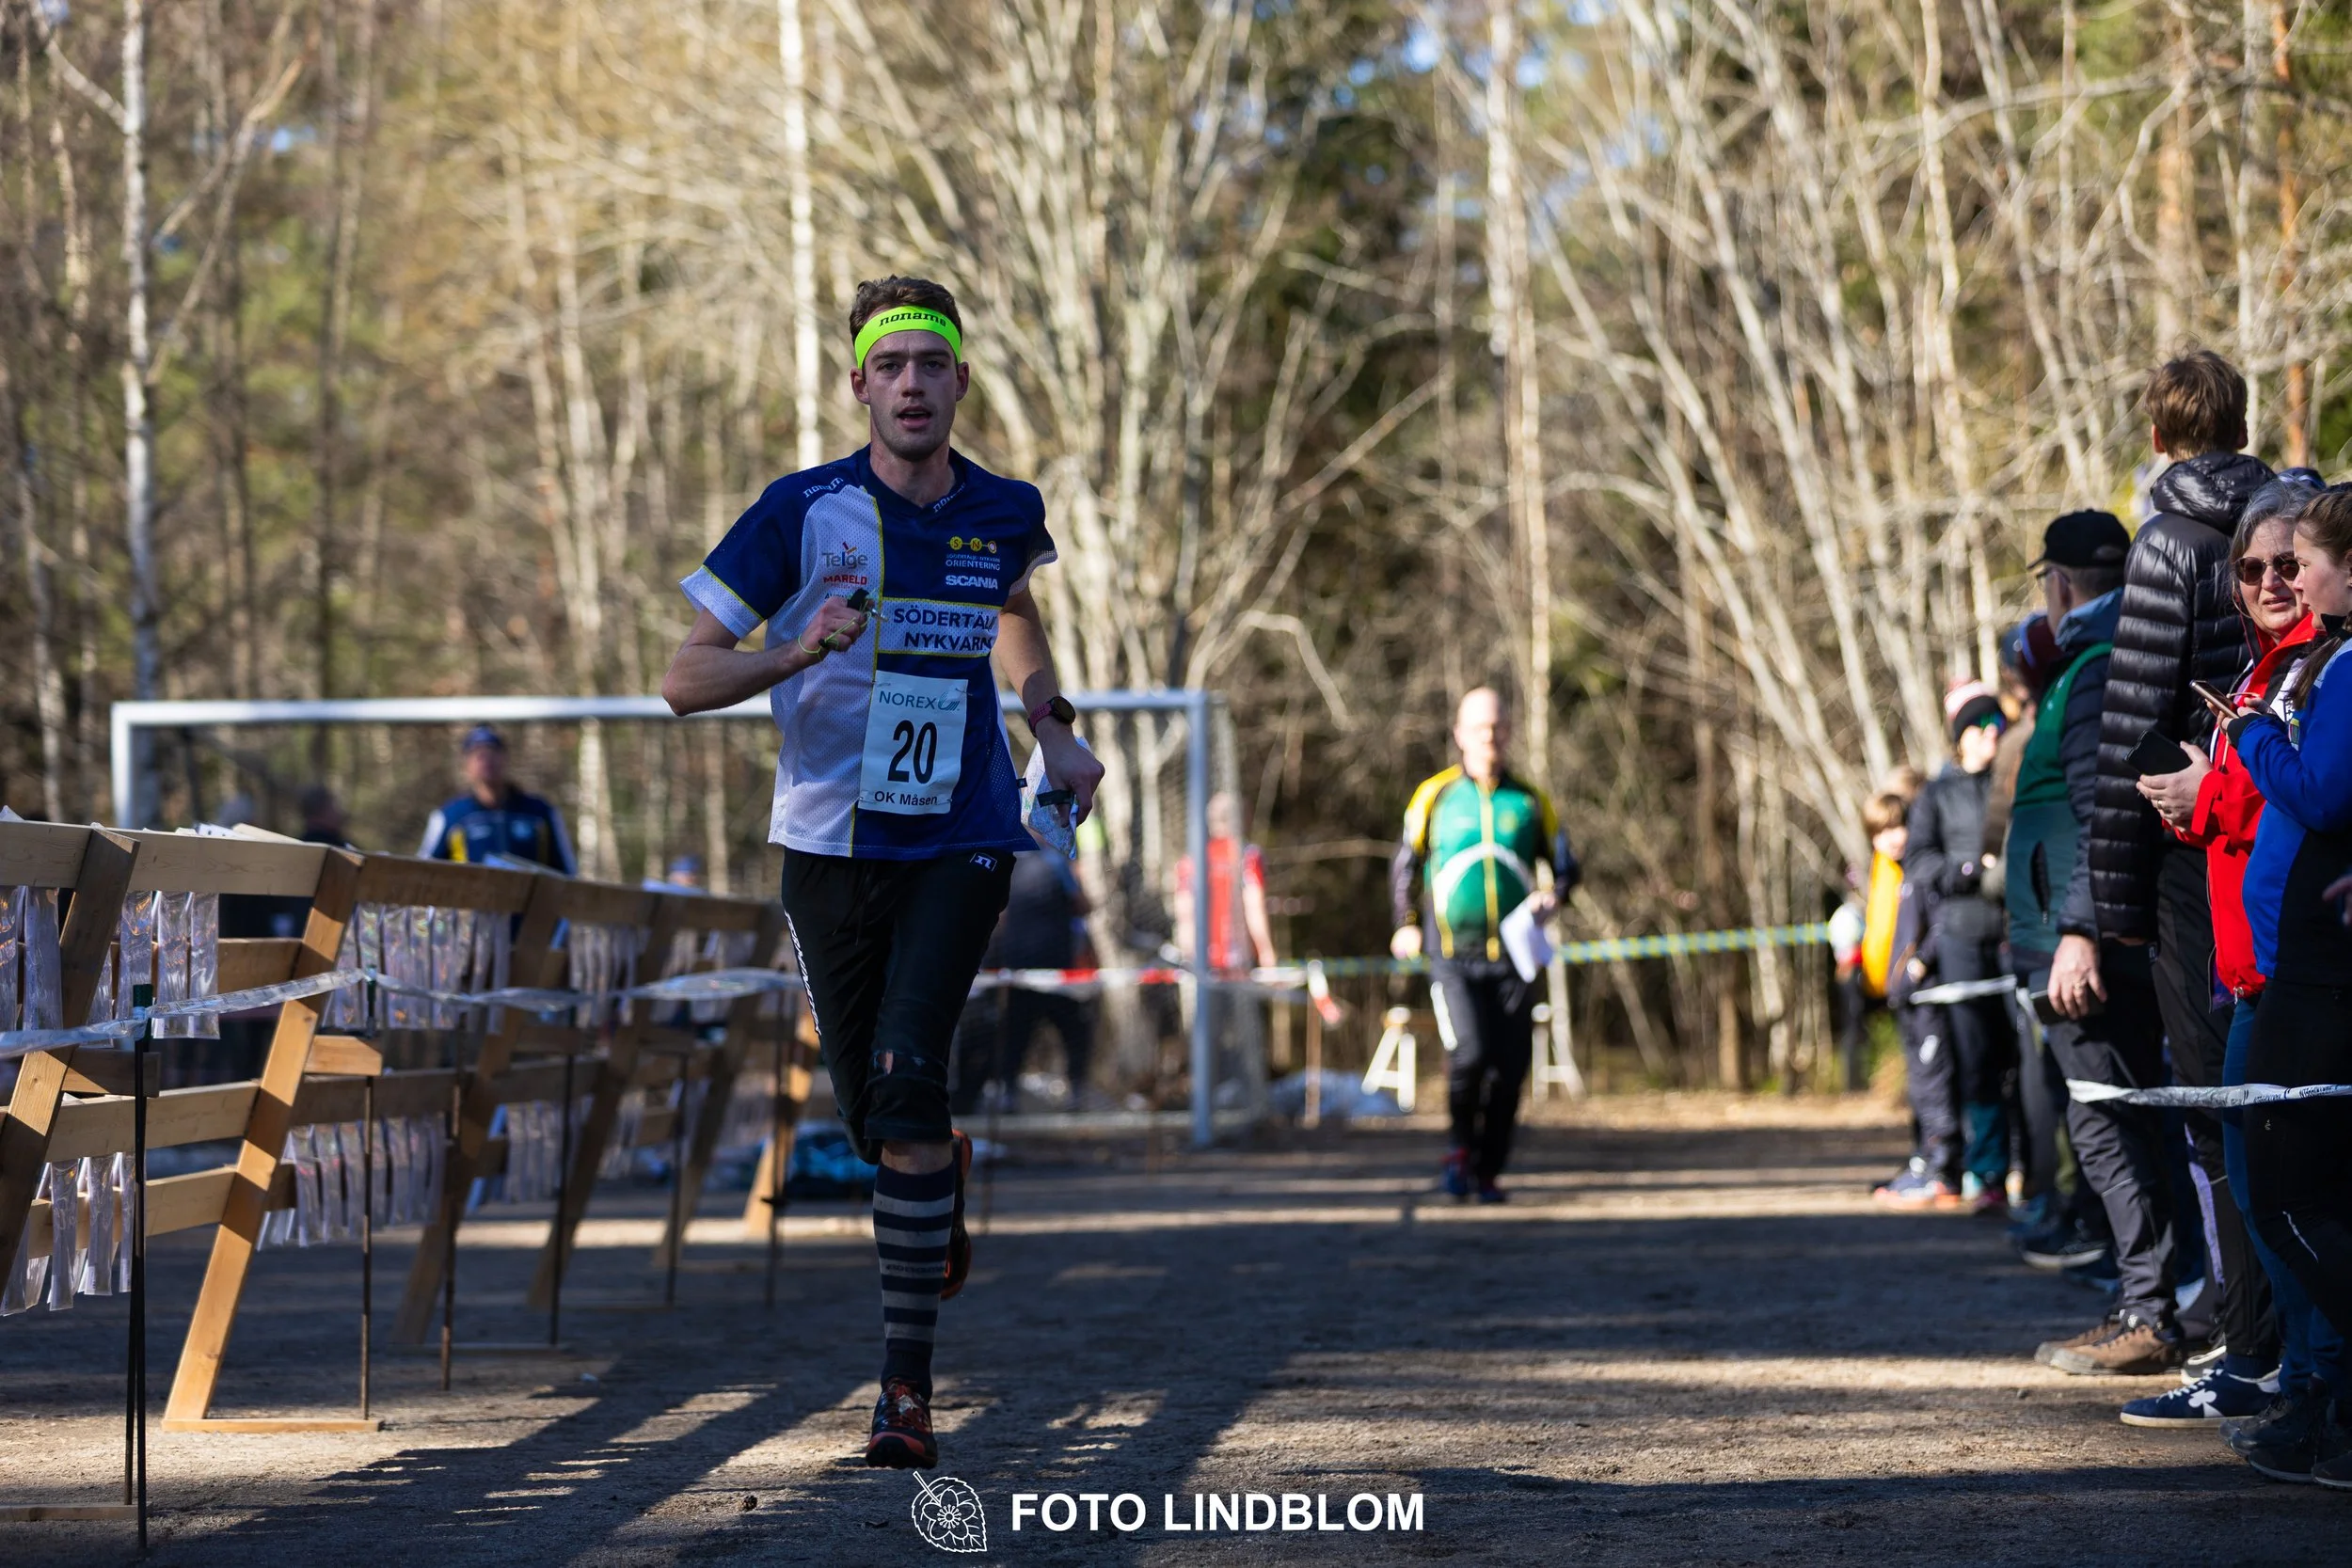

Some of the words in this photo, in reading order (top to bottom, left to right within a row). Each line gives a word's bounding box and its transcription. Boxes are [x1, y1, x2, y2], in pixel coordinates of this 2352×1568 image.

[879, 312, 946, 327] noname
[821, 550, 868, 569] Telge
[946, 559, 1000, 571] ORIENTERING
[946, 575, 998, 590] SCANIA
[904, 632, 993, 651] NYKVARN
[879, 690, 936, 710] NOREX
[887, 720, 938, 784] 20
[874, 791, 896, 803] OK
[899, 794, 938, 806] Måsen
